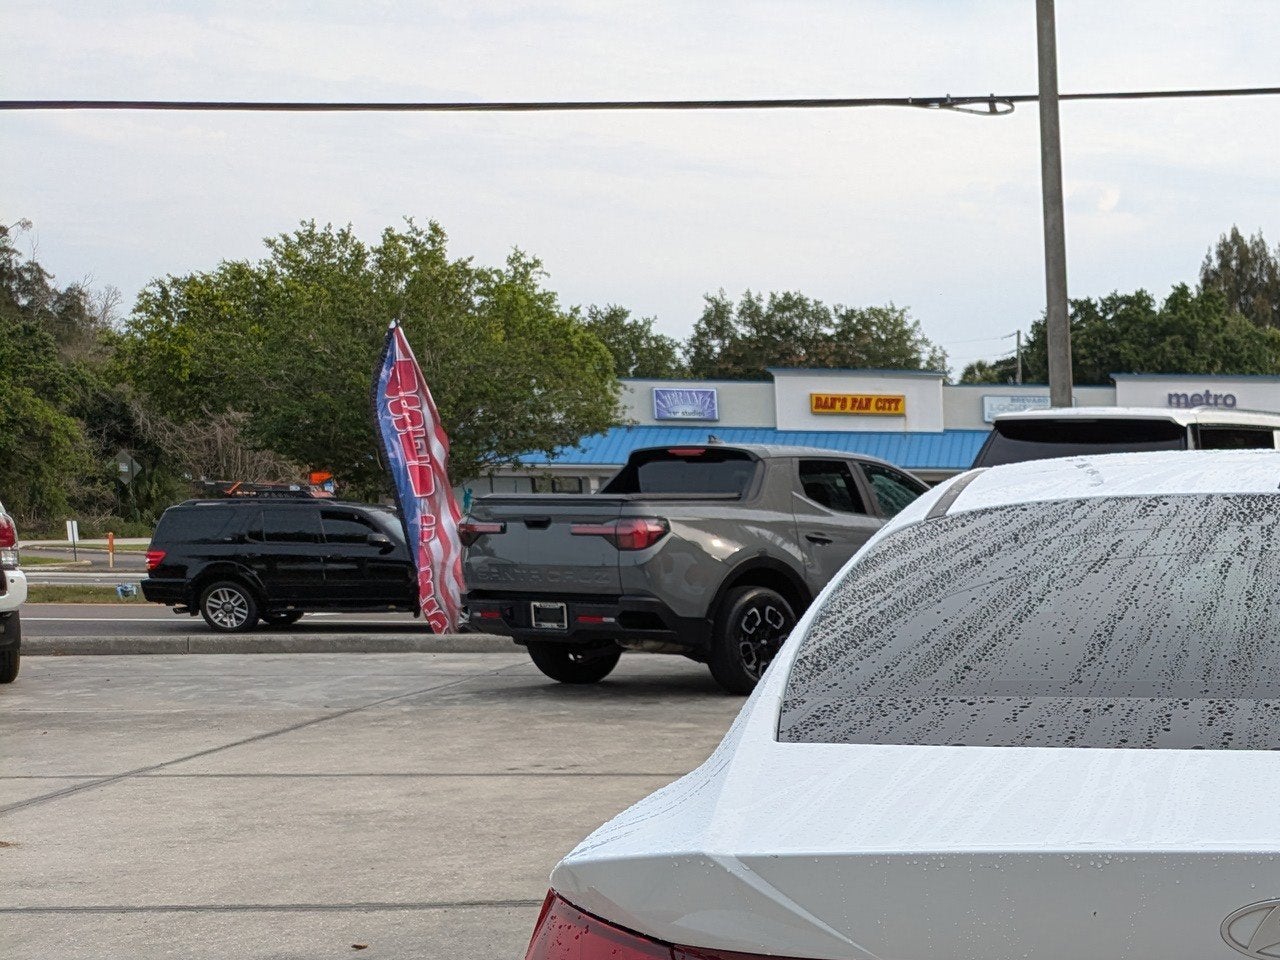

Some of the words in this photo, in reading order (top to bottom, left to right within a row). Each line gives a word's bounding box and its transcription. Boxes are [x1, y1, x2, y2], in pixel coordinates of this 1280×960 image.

[814, 396, 848, 410] DAN'S
[849, 397, 873, 411] FAN
[874, 397, 902, 411] CITY
[1168, 389, 1237, 408] metro
